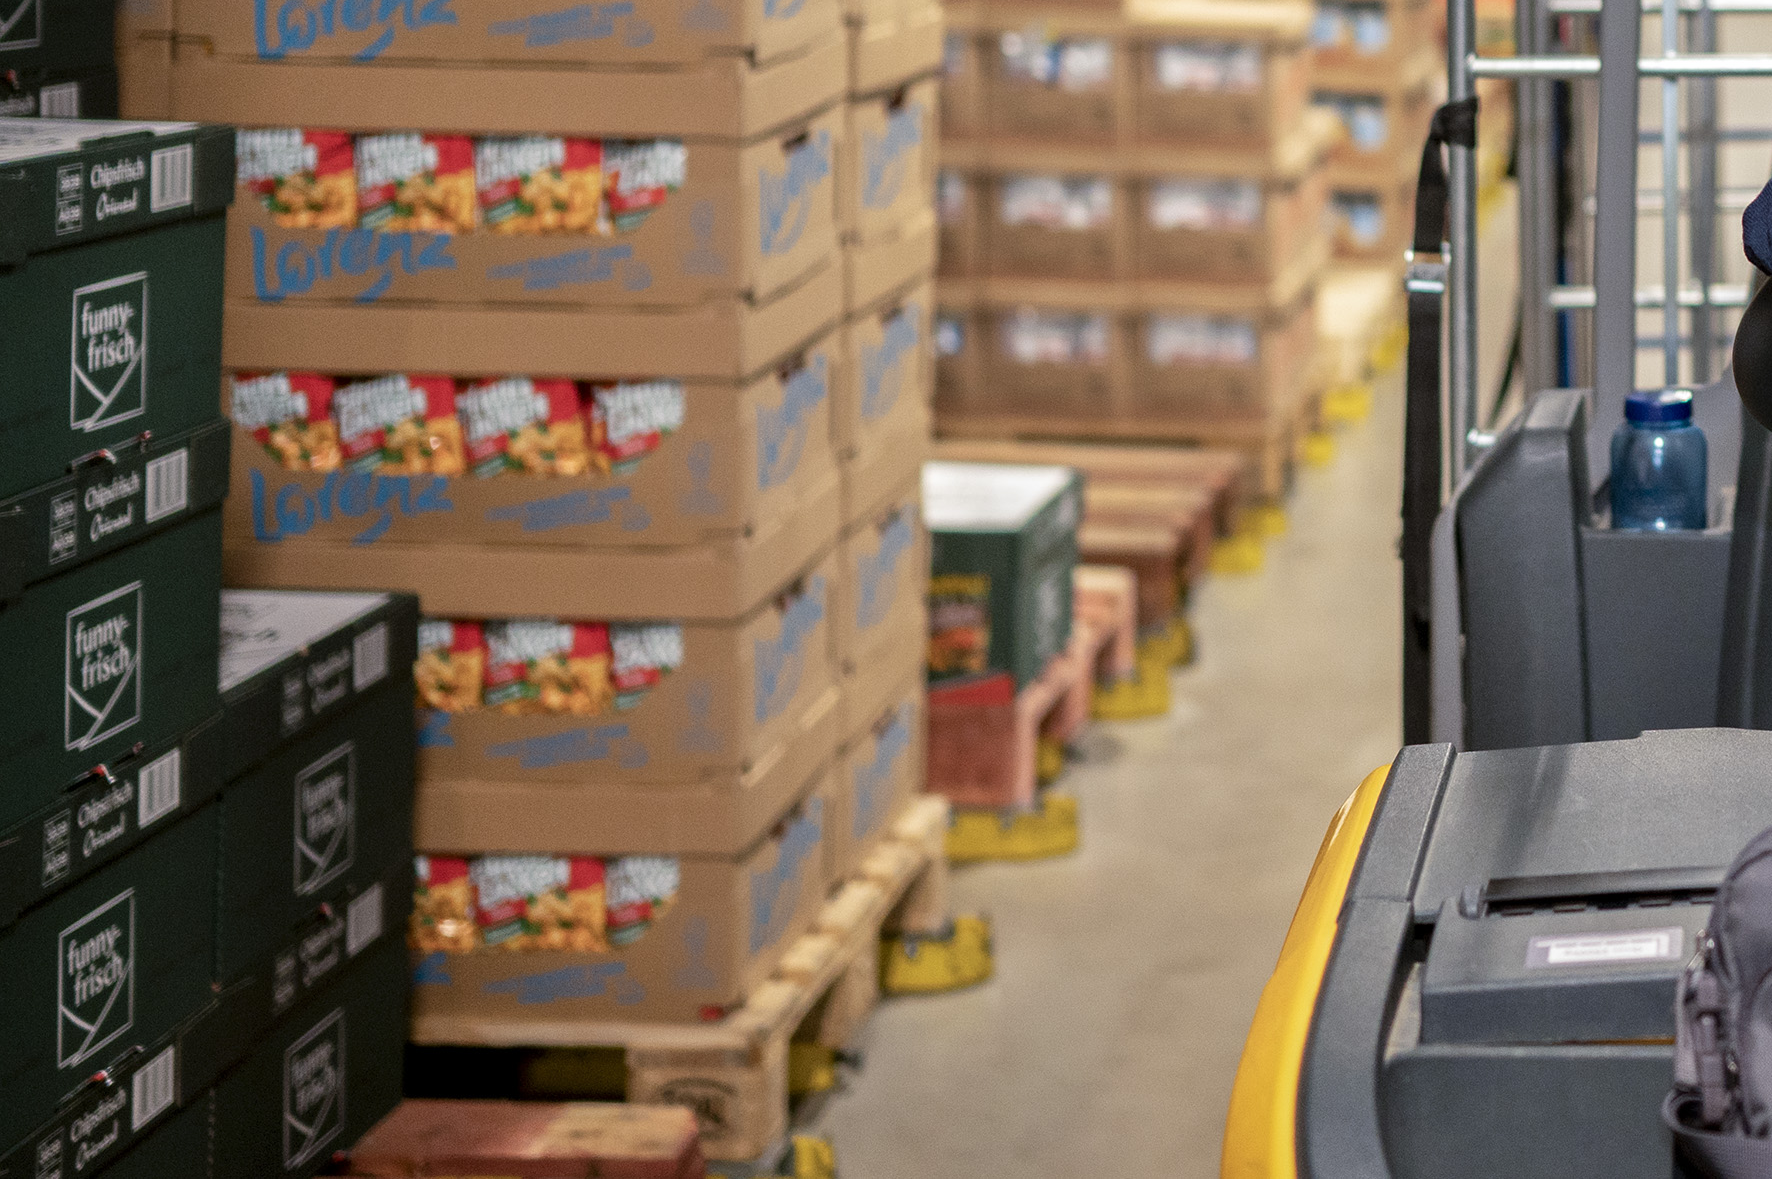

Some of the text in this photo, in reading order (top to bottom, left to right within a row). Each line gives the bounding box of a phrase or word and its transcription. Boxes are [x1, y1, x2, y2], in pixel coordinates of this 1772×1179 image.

[249, 226, 456, 304] Lorenz
[82, 300, 134, 339] funny-
[87, 330, 136, 372] frisch
[248, 469, 452, 547] Lorenz
[75, 614, 130, 658] funny-
[81, 642, 130, 692] frisch
[68, 924, 122, 976] funny-
[74, 950, 124, 1008] frisch
